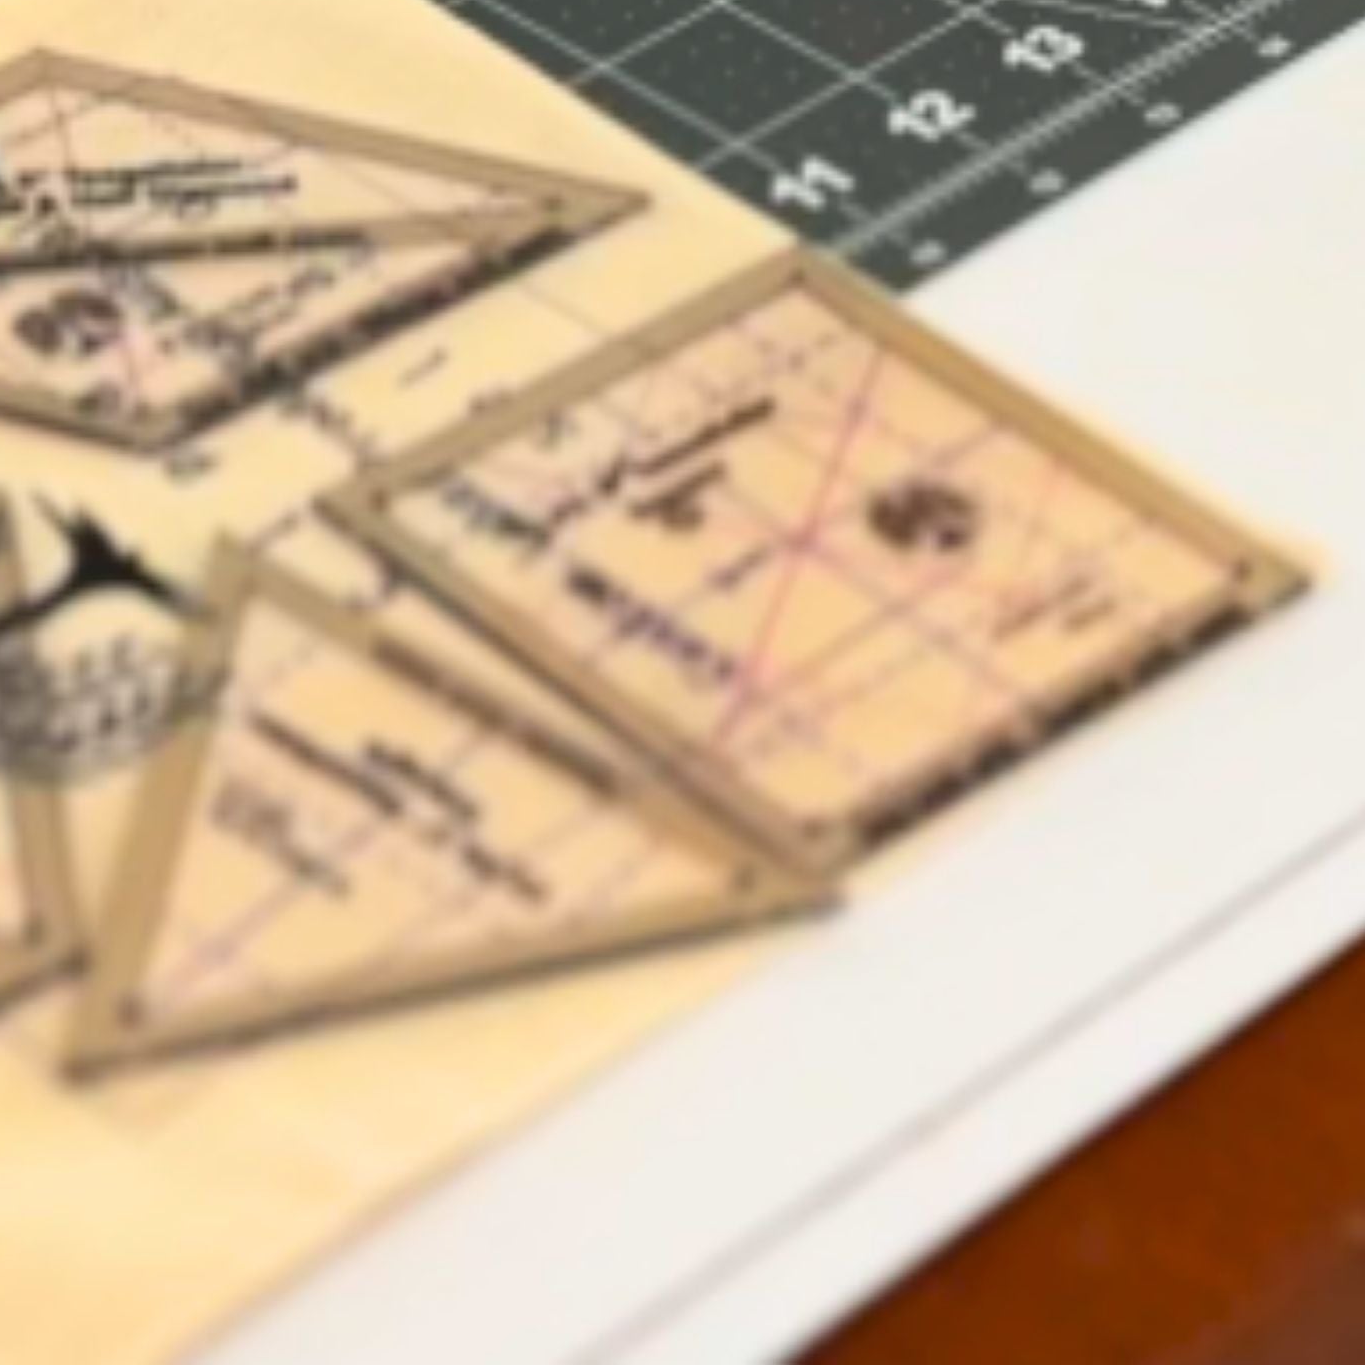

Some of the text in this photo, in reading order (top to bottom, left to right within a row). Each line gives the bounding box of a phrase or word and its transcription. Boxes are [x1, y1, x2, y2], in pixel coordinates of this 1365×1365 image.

[1003, 24, 1086, 71] 13
[888, 89, 976, 142] 12
[772, 154, 855, 209] 11
